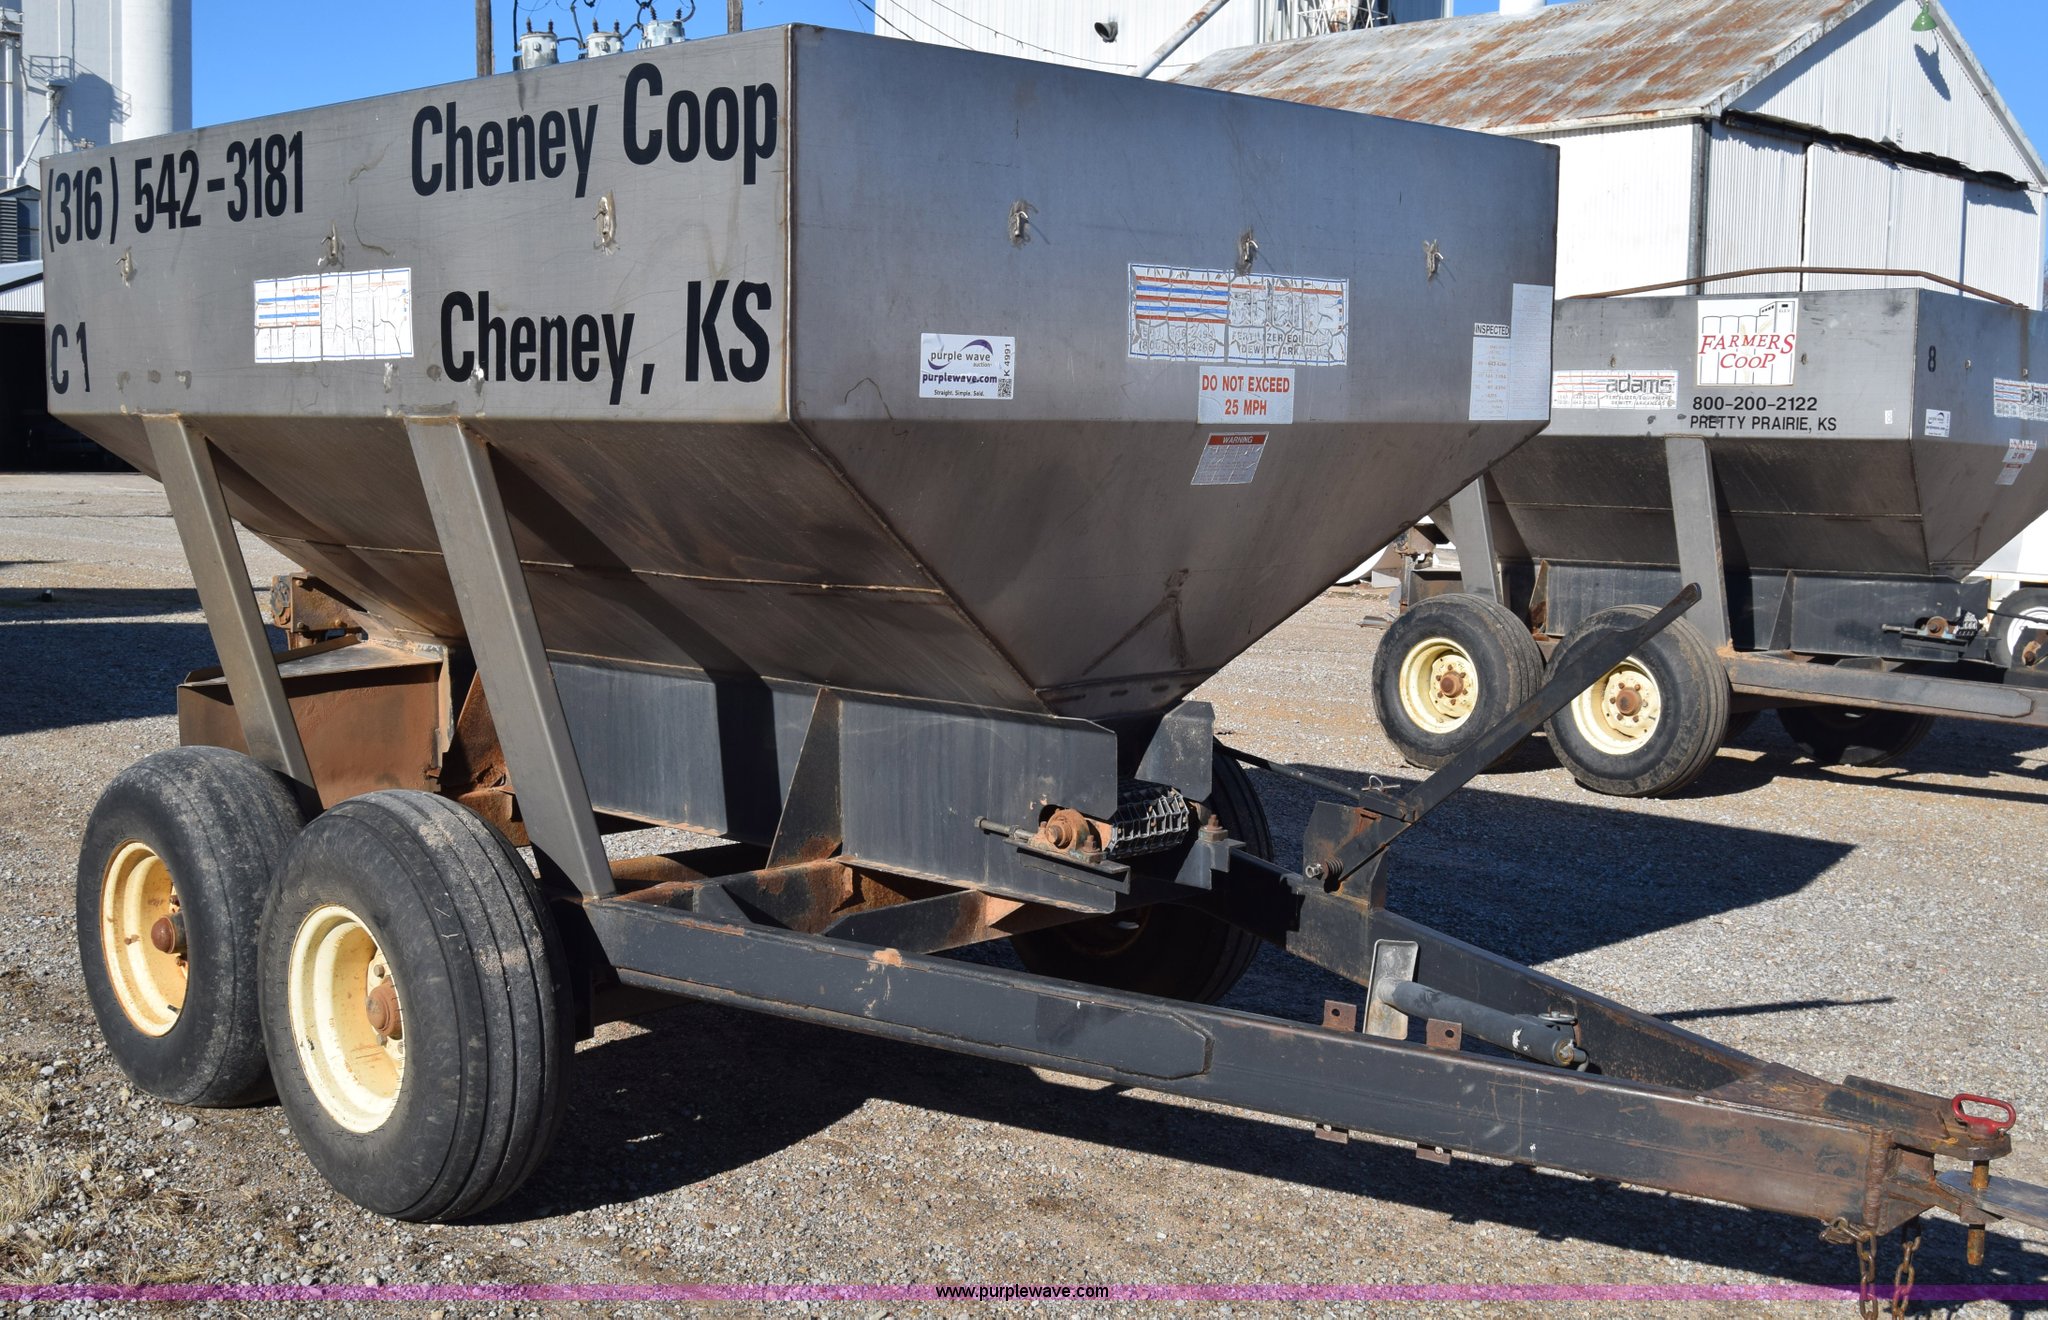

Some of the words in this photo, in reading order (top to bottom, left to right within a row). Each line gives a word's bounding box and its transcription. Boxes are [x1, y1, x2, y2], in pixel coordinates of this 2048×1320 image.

[411, 101, 599, 198] Cheney
[623, 63, 778, 185] Coop
[47, 156, 119, 253] (316)
[134, 130, 304, 234] 542-3181
[1475, 324, 1509, 336] INSPECTED
[440, 290, 655, 406] Cheney,
[684, 279, 772, 383] KS
[1698, 334, 1796, 355] FARMERS
[931, 351, 962, 362] purple
[966, 353, 991, 361] wave
[1928, 345, 1937, 372] 8
[922, 372, 998, 384] purplewave.com
[1202, 374, 1218, 391] DO
[1222, 375, 1244, 392] NOT
[1247, 376, 1290, 393] EXCEED
[1606, 374, 1673, 394] adams
[934, 389, 954, 397] Straight.
[1224, 399, 1239, 415] 25
[1243, 399, 1267, 416] MPH
[1692, 396, 1818, 411] 800-200-2122
[1690, 415, 1746, 430] PRETTY
[1751, 416, 1812, 434] PRAIRIE,
[1818, 416, 1837, 431] KS
[1222, 436, 1254, 444] WARNING
